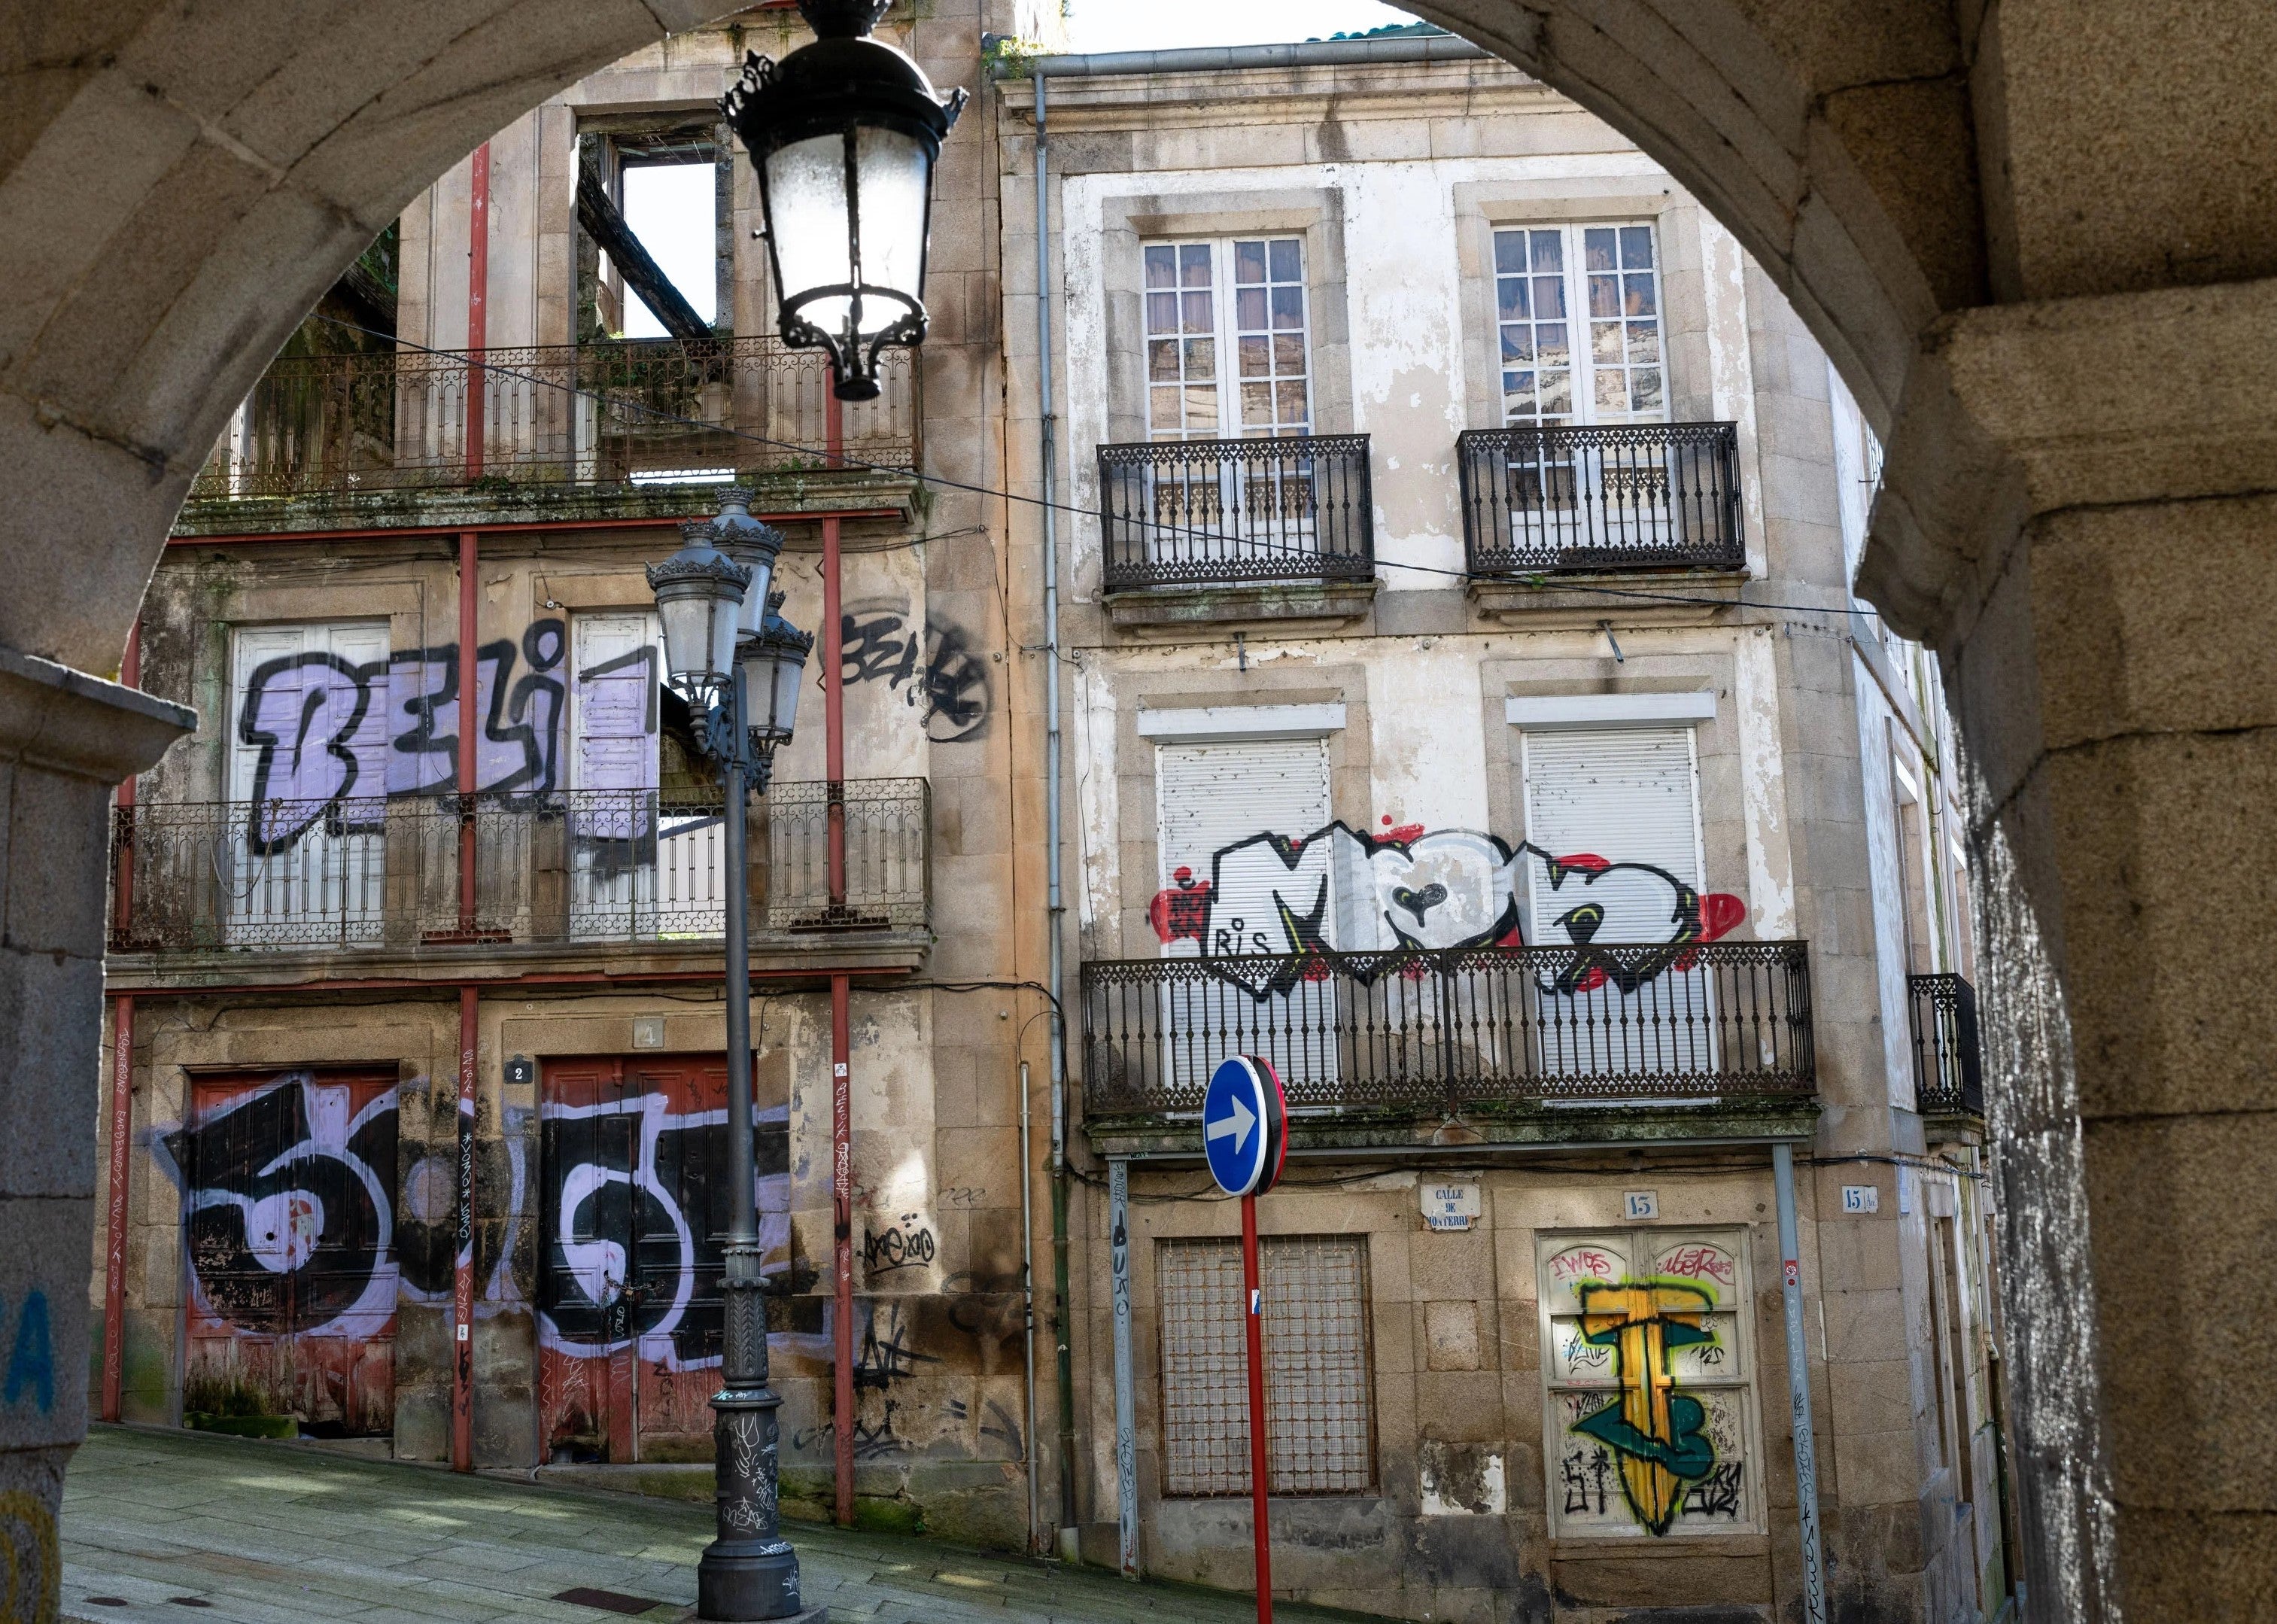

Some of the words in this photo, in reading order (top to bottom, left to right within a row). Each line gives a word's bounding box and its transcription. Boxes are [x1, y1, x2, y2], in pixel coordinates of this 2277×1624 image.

[641, 1023, 656, 1045] 4
[515, 1067, 523, 1080] 2
[1436, 1189, 1464, 1200] CALLE
[1846, 1189, 1861, 1209] 15
[1446, 1203, 1456, 1212] DE
[1630, 1196, 1651, 1215] 13
